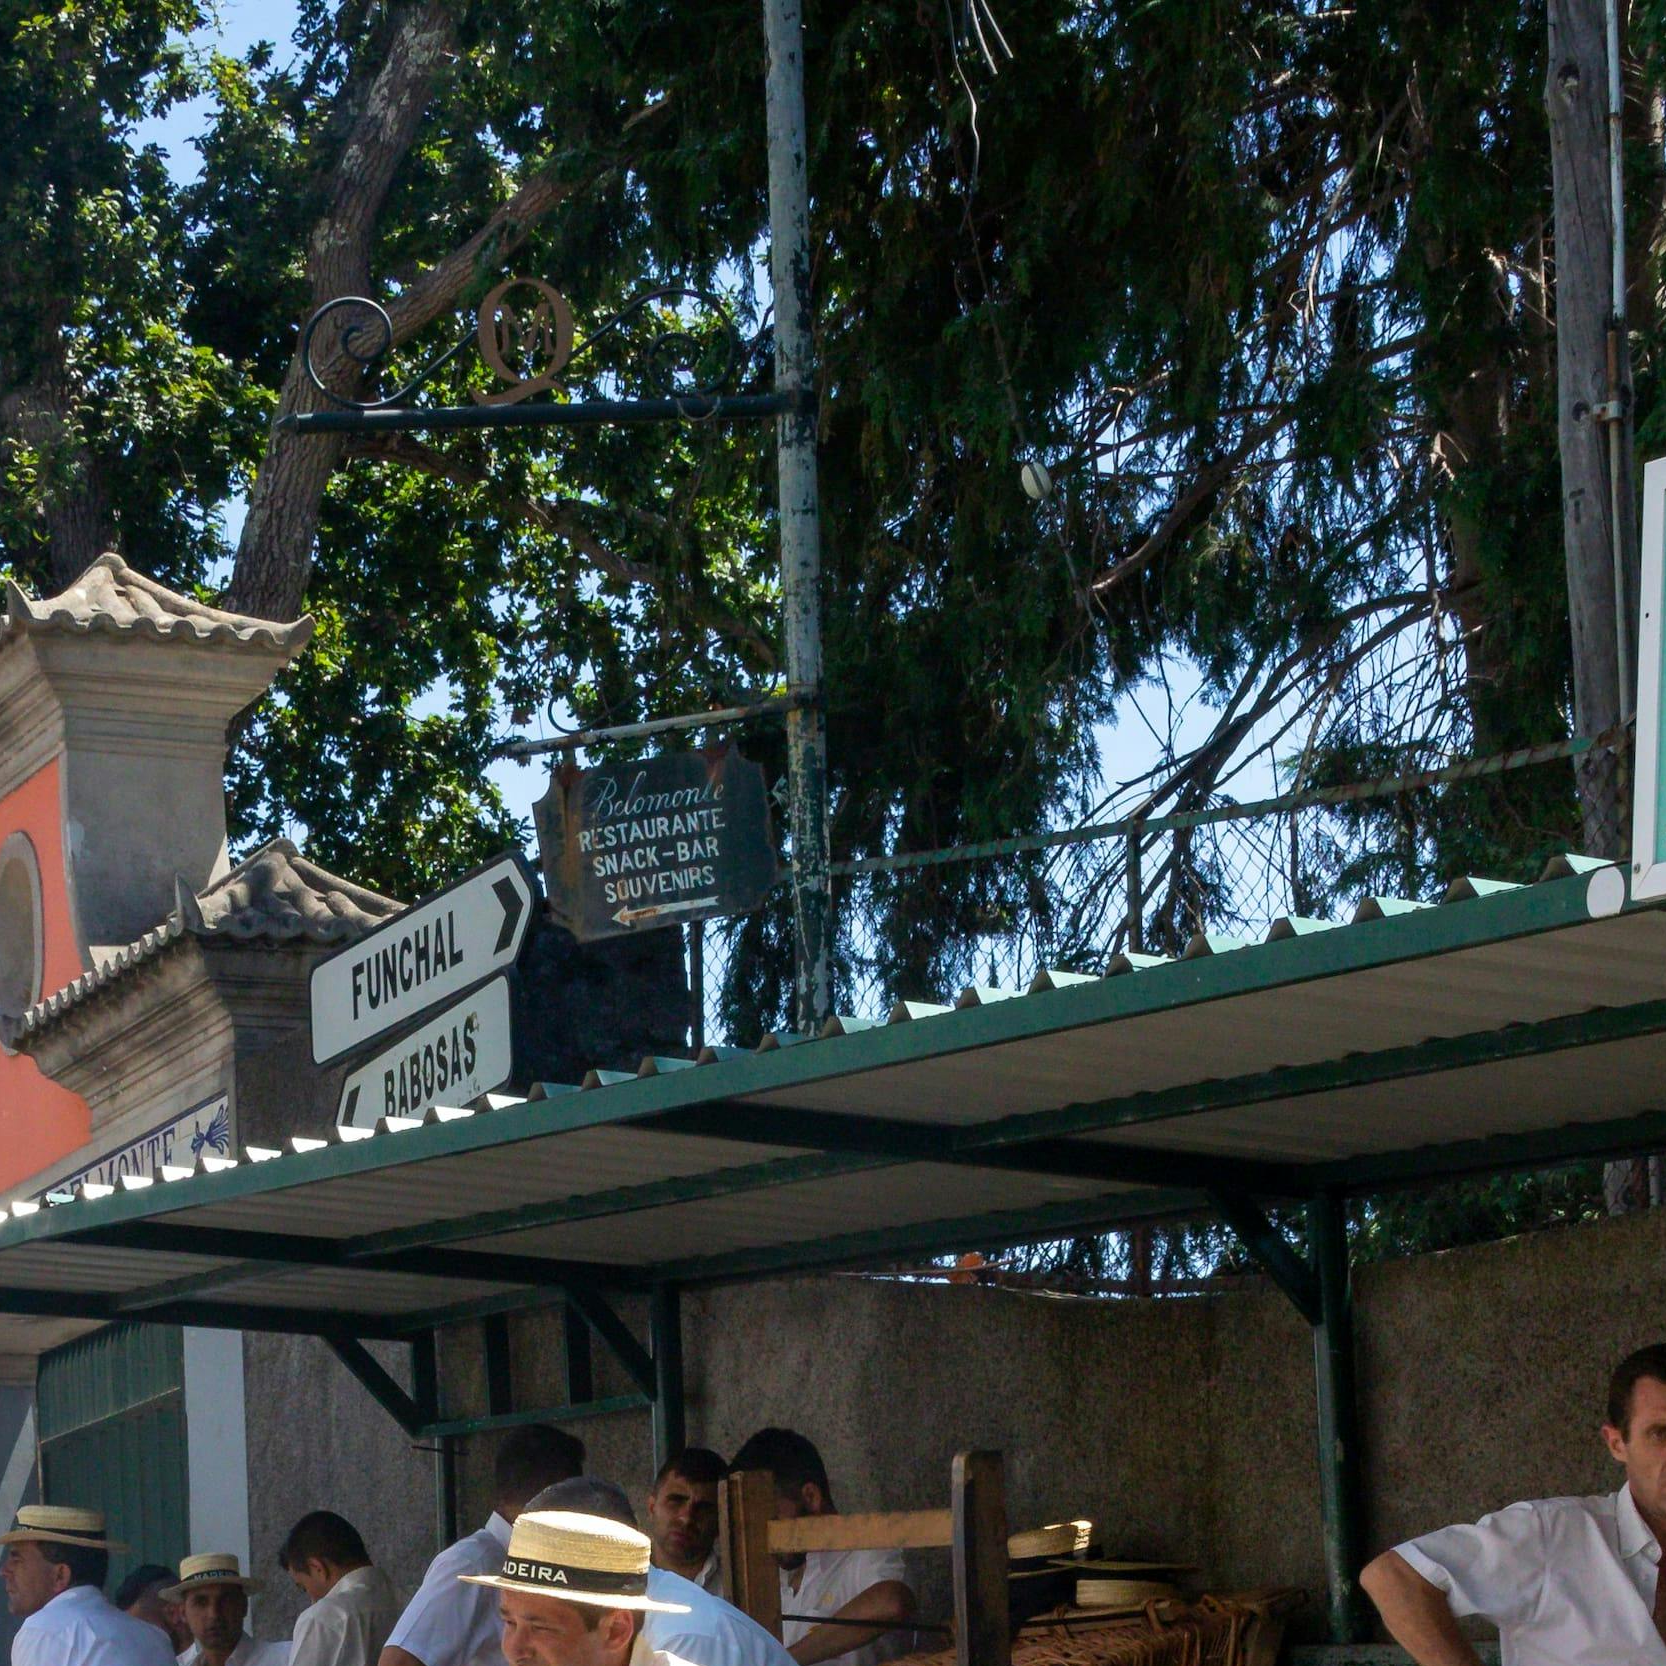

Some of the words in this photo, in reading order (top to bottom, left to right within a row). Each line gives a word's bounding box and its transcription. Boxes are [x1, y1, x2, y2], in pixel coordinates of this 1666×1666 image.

[577, 808, 726, 852] RESTAURANTE
[604, 866, 715, 903] SOUVENIRS
[352, 910, 463, 1020] FUNCHAL
[384, 1013, 476, 1117] BABOSAS
